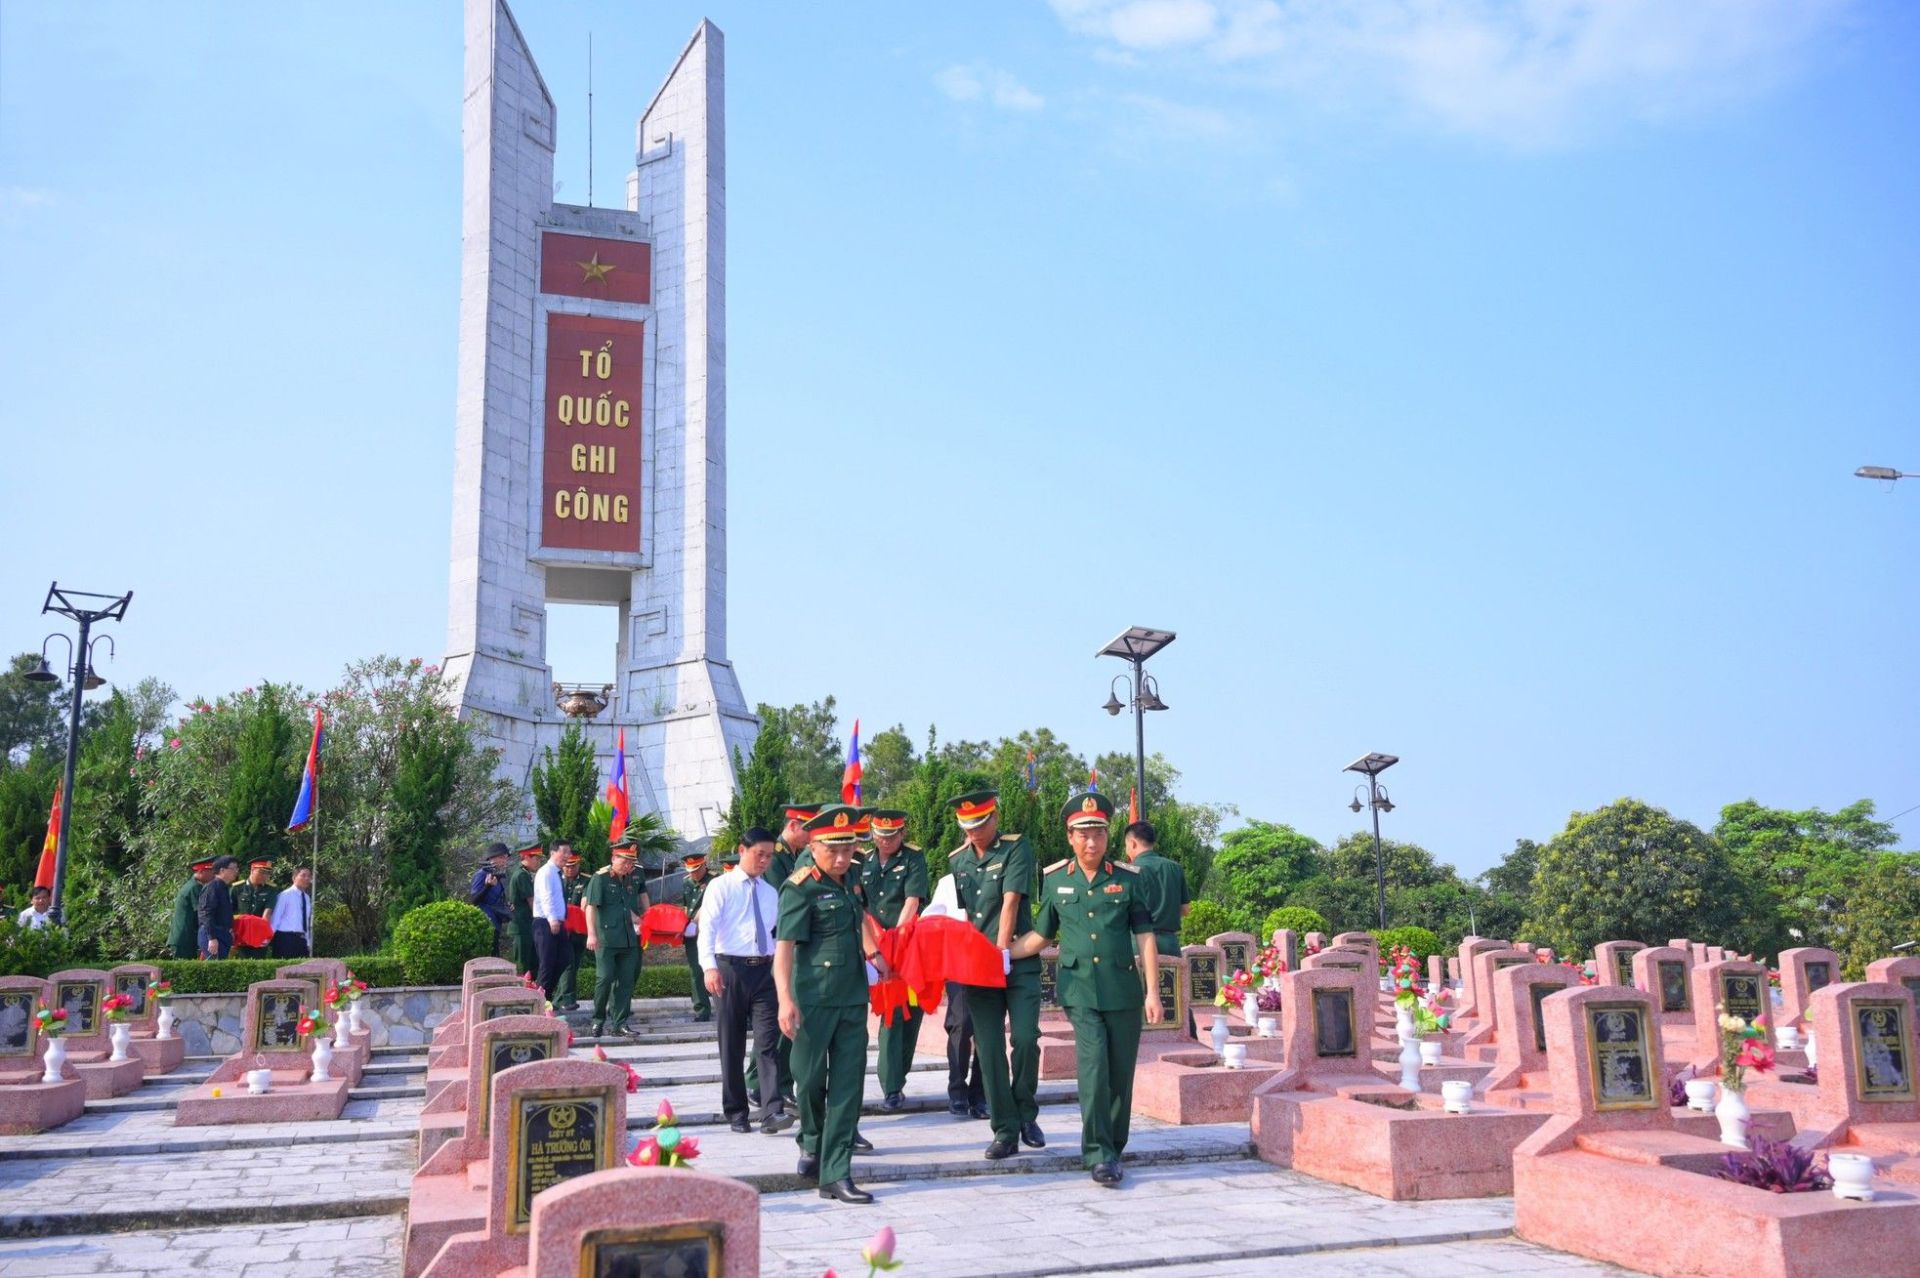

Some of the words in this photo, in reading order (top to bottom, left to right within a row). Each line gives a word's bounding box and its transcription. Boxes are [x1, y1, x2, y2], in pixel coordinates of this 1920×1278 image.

[579, 340, 613, 379] TỔ
[558, 390, 629, 428] QUỐC
[571, 443, 615, 474] GHI
[555, 486, 628, 523] CÔNG
